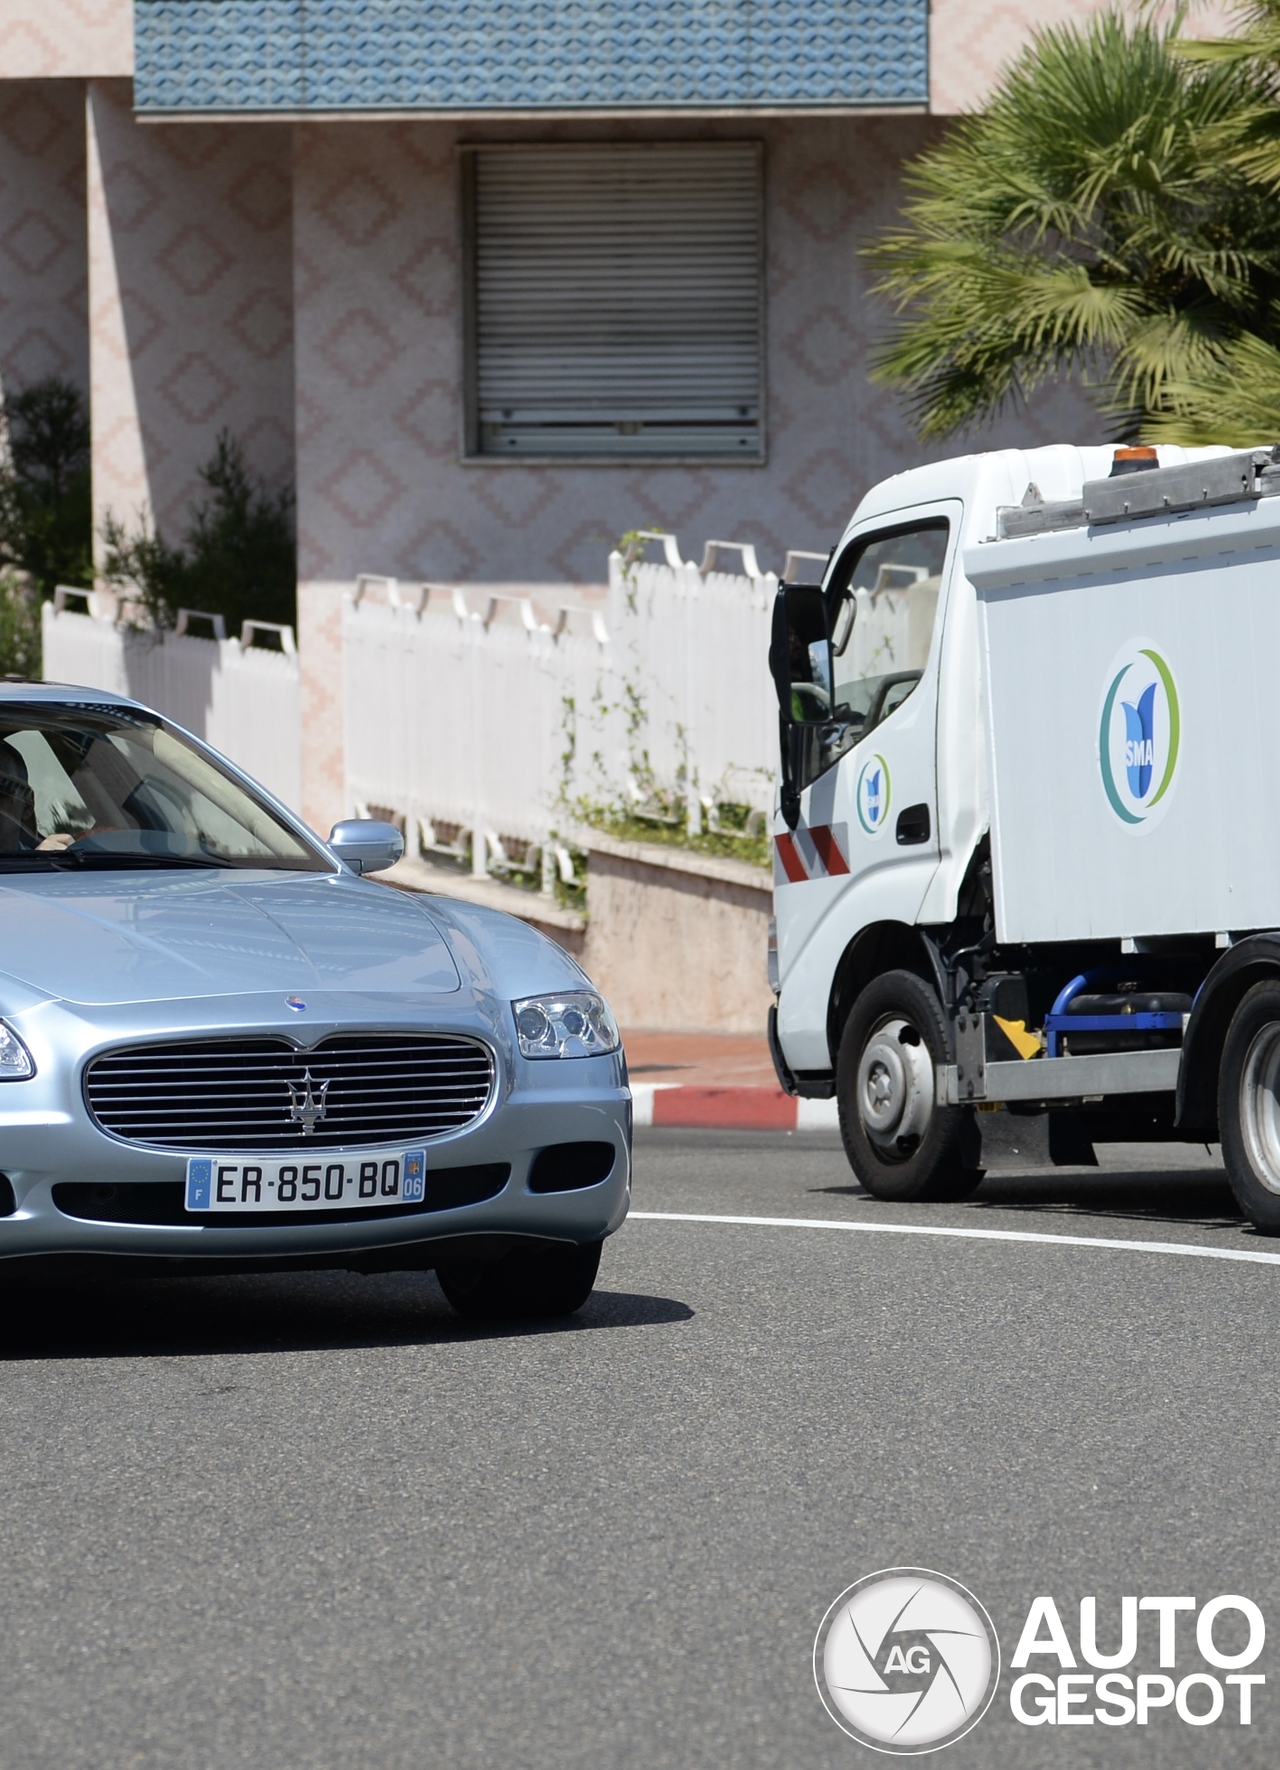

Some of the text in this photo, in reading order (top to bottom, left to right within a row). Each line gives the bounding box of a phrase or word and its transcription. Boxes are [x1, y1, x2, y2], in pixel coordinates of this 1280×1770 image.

[1126, 739, 1153, 767] SMA
[194, 1189, 203, 1201] F
[404, 1177, 422, 1196] 06
